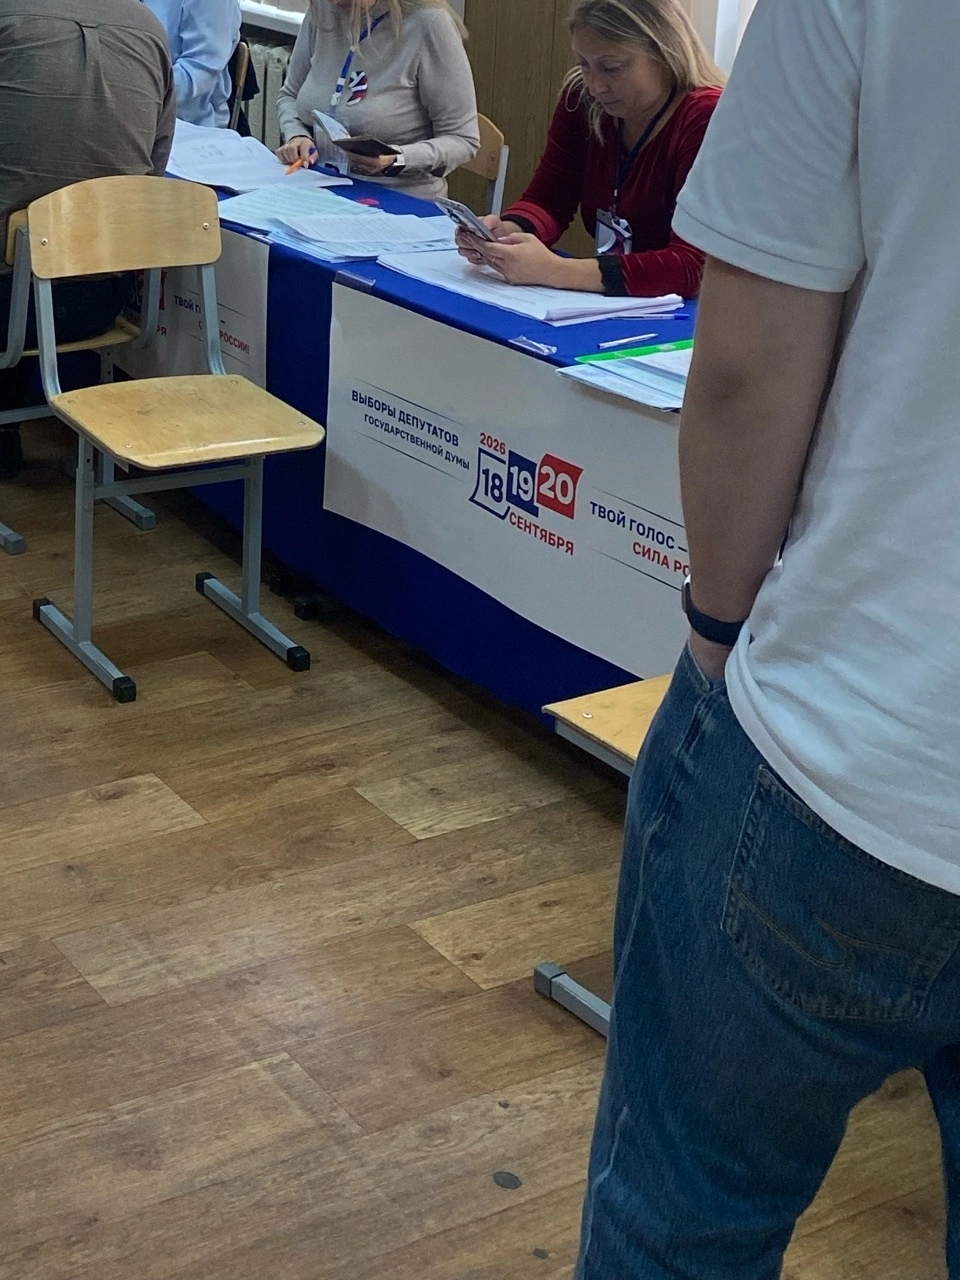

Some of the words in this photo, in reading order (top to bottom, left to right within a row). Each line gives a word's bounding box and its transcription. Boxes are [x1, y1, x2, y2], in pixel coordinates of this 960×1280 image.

[174, 295, 194, 312] ТВОЙ
[351, 389, 397, 420] ВЫБОРЫ
[397, 410, 459, 447] ДЕПУТАТОВ
[364, 413, 444, 457] ГОСУДАРСТВЕННОЙ
[444, 451, 470, 471] ДУМЫ
[479, 432, 507, 455] 2026
[481, 467, 504, 503] 18
[509, 465, 534, 501] 19
[539, 468, 574, 505] 20
[509, 512, 575, 556] СЕНТЯБРЯ
[589, 501, 626, 528] ТВОЙ
[629, 519, 675, 549] ГОЛОС
[633, 541, 670, 569] СИЛА
